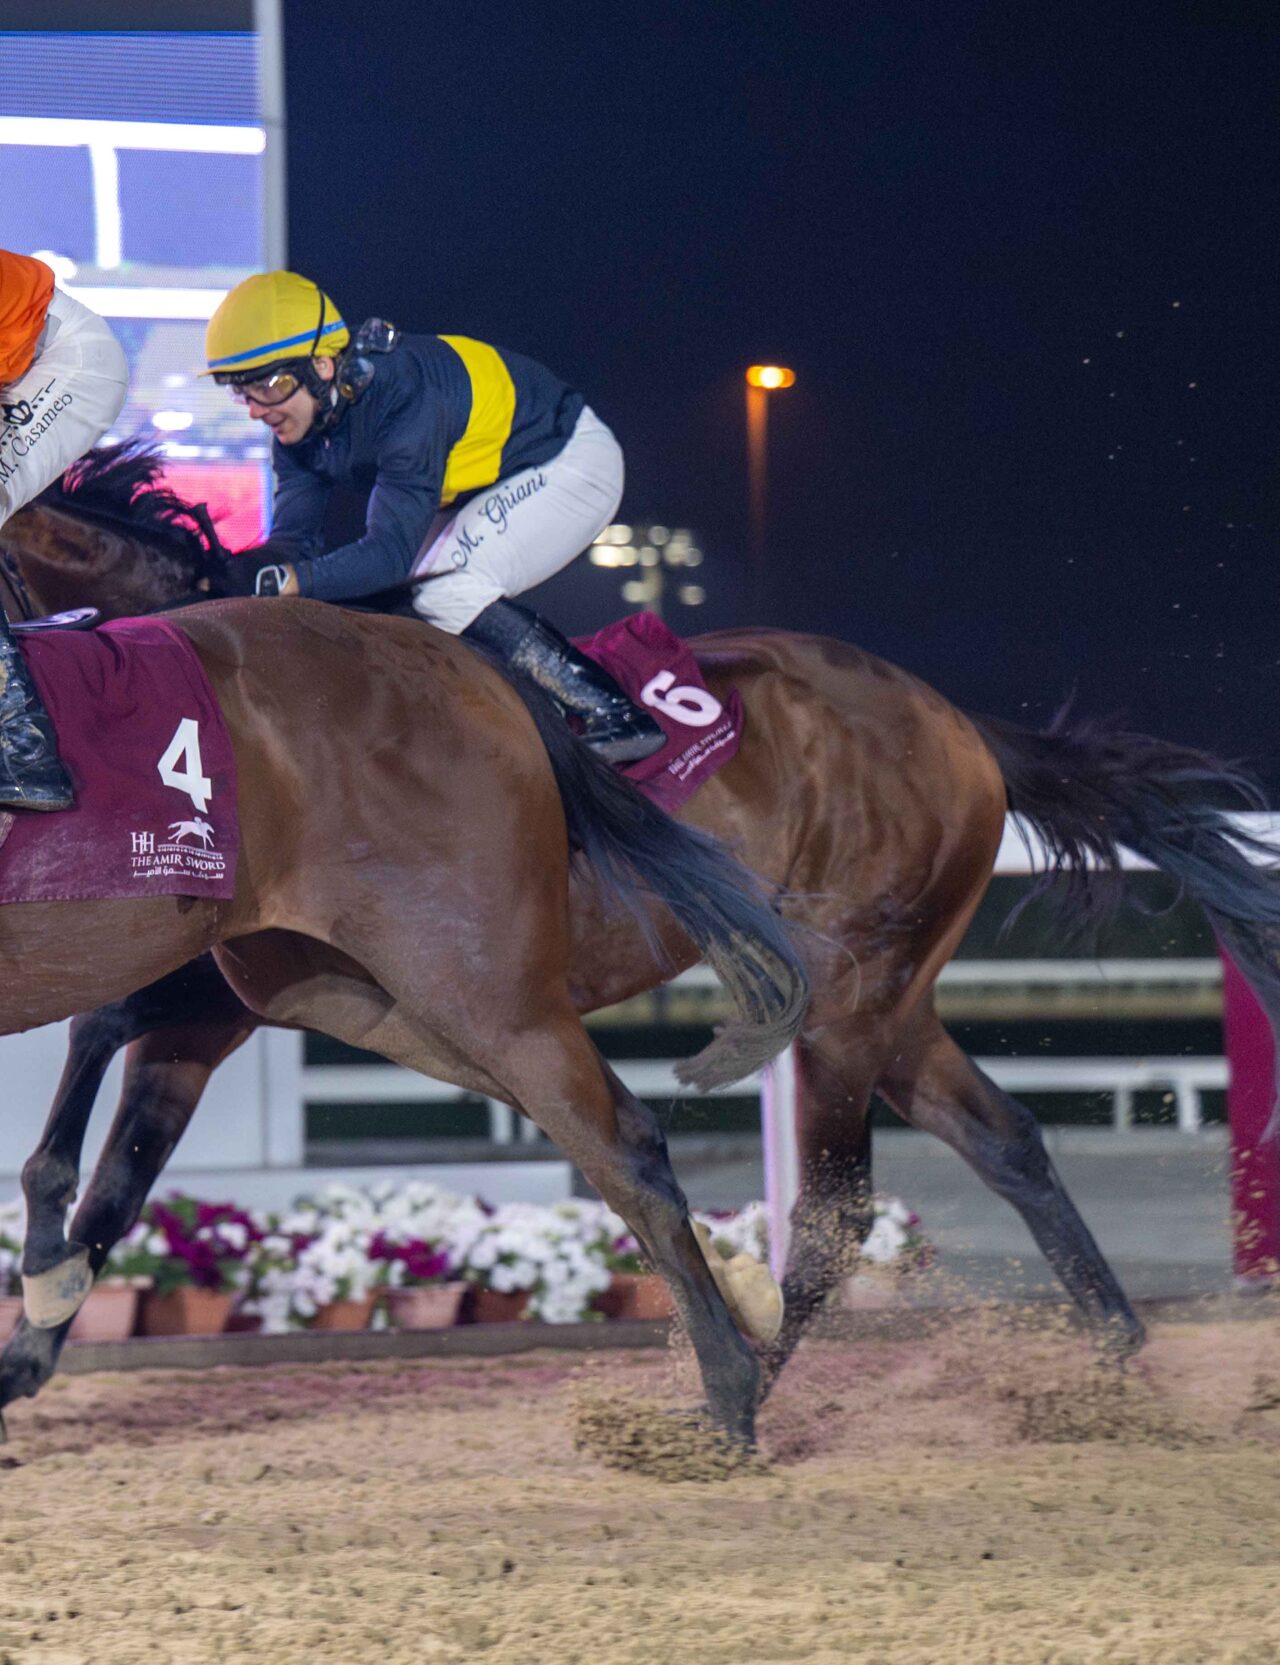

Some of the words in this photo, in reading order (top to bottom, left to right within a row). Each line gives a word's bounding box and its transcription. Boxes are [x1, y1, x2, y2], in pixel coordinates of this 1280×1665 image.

[451, 525, 484, 569] M.
[478, 467, 547, 535] Ghiani
[640, 669, 723, 727] 6
[157, 717, 213, 814] 4
[130, 856, 152, 867] THE
[153, 854, 184, 867] AMIR
[186, 857, 226, 870] SWORD
